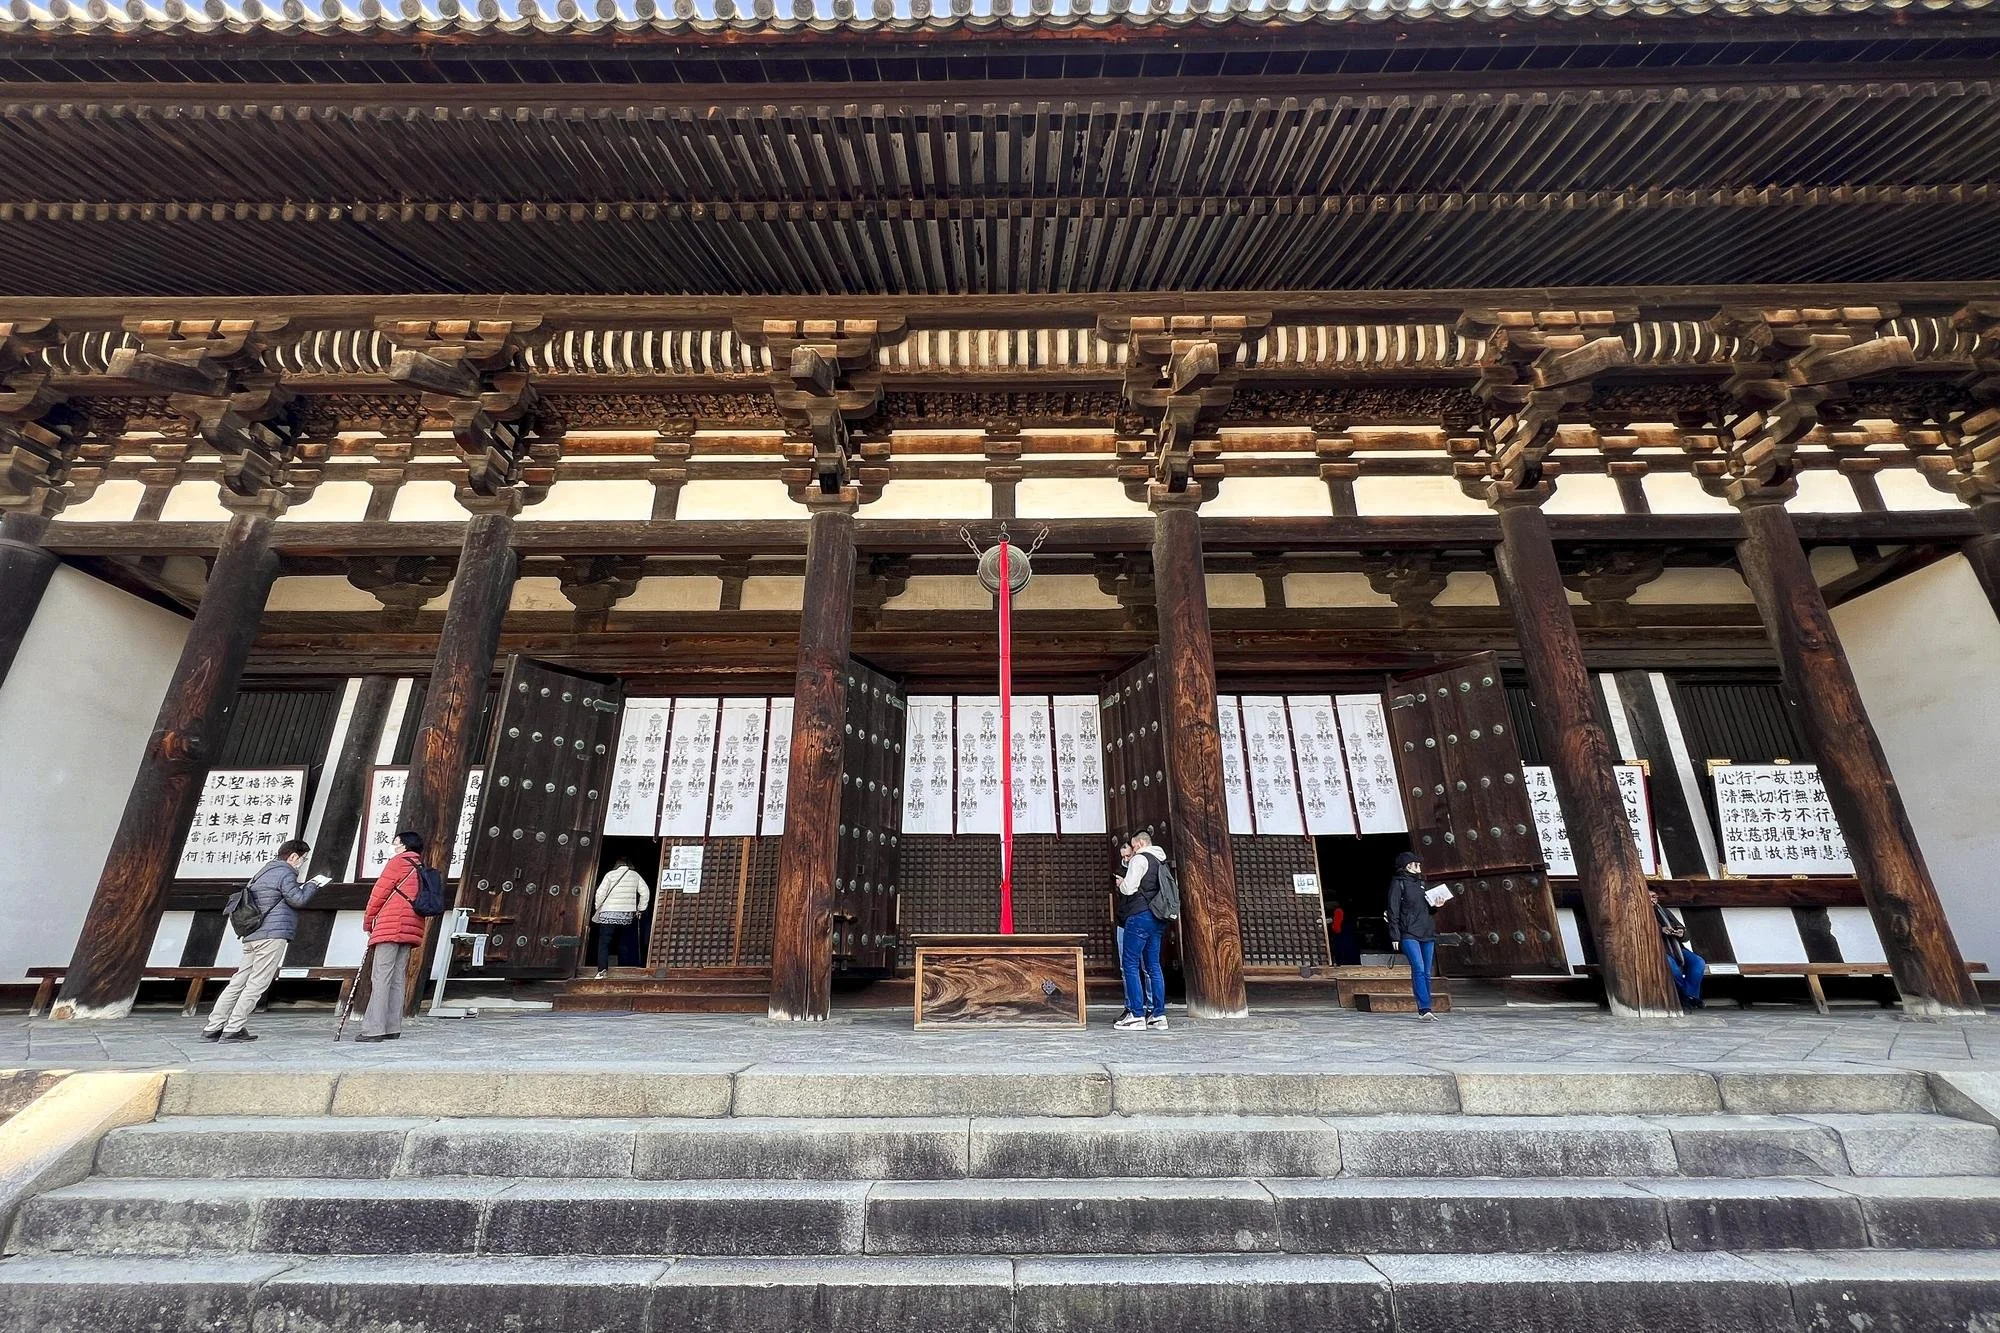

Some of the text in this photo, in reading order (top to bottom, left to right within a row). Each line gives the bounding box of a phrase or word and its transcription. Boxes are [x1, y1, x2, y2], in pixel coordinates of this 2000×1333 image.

[221, 775, 244, 863] 望文殊師利
[274, 775, 295, 861] 無悔何謂
[1756, 773, 1784, 860] 一切示現故
[1773, 771, 1800, 860] 故行方便慈
[1793, 771, 1818, 860] 慈無不知時
[664, 873, 681, 882] 入口
[1297, 877, 1314, 886] 出口
